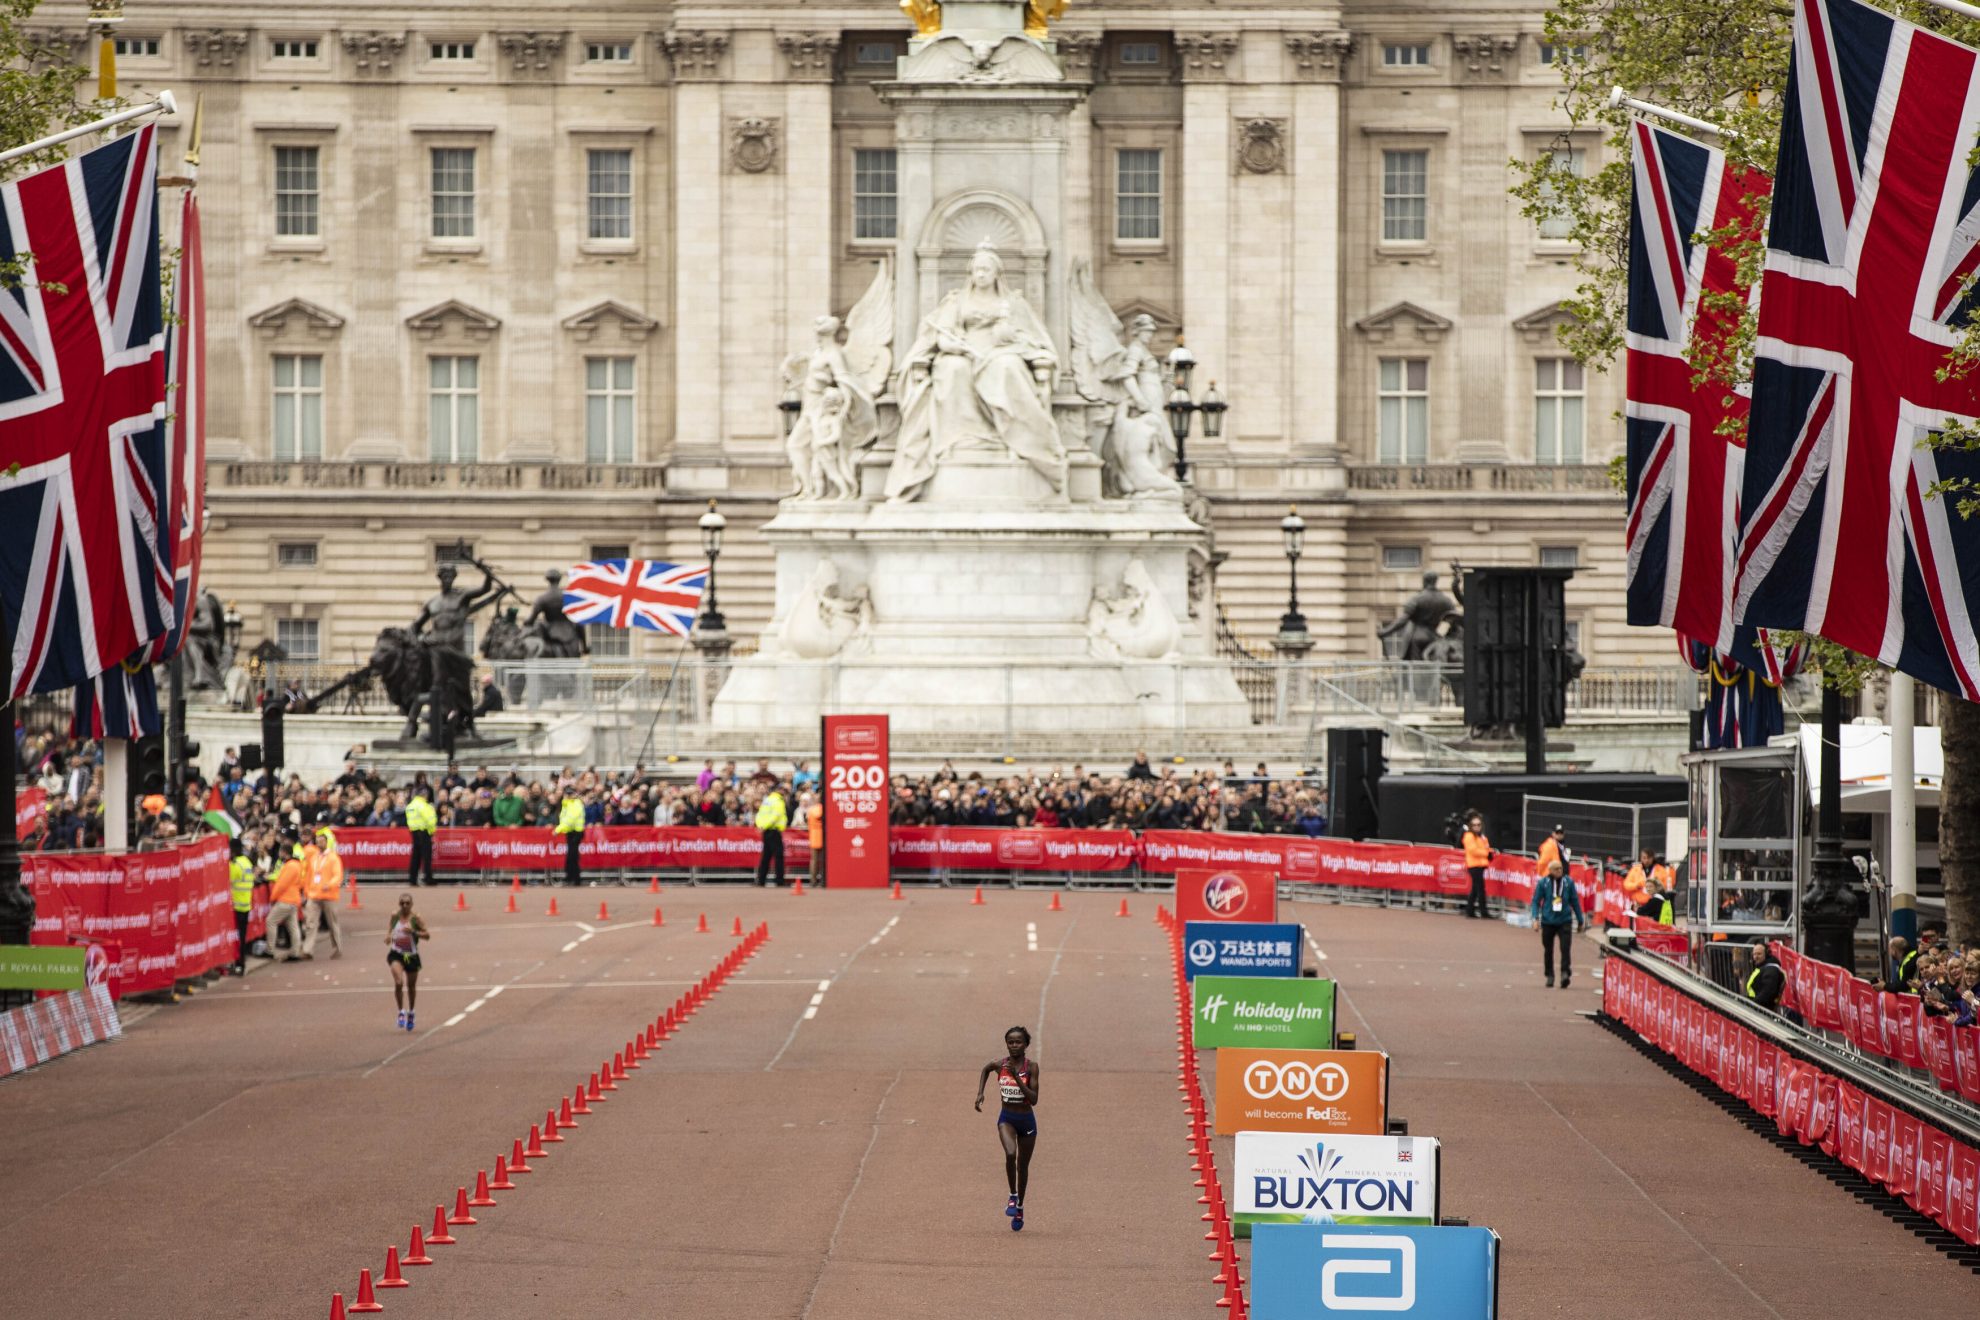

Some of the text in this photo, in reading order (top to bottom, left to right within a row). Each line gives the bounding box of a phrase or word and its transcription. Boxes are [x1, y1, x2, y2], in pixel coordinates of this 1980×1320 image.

[830, 765, 885, 789] 200
[832, 790, 882, 801] METRES
[837, 801, 877, 813] TO GO
[476, 841, 507, 858] Virgin
[511, 841, 546, 858] Money
[899, 839, 938, 852] London
[940, 839, 992, 853] Marathon
[1046, 842, 1077, 858] Virgin
[1078, 842, 1116, 858] Money
[1146, 843, 1176, 861] Virgin
[1177, 845, 1210, 863] Money
[1211, 847, 1243, 861] London
[1244, 848, 1281, 864] Marathon
[1321, 854, 1345, 872] Virgin
[1346, 857, 1371, 874] Money
[1372, 859, 1400, 874] London
[1401, 861, 1434, 876] Marathon
[1208, 878, 1244, 911] Virgin
[1221, 940, 1292, 956] 万达体育
[11, 963, 45, 973] ROYAL
[47, 963, 79, 973] PARKS
[1221, 957, 1292, 967] WANDA SPORTS
[1233, 1001, 1323, 1022] Holiday Inn
[1265, 1024, 1292, 1032] HOTEL
[1245, 1106, 1347, 1121] will become FedEx
[1254, 1176, 1413, 1212] BUXTON
